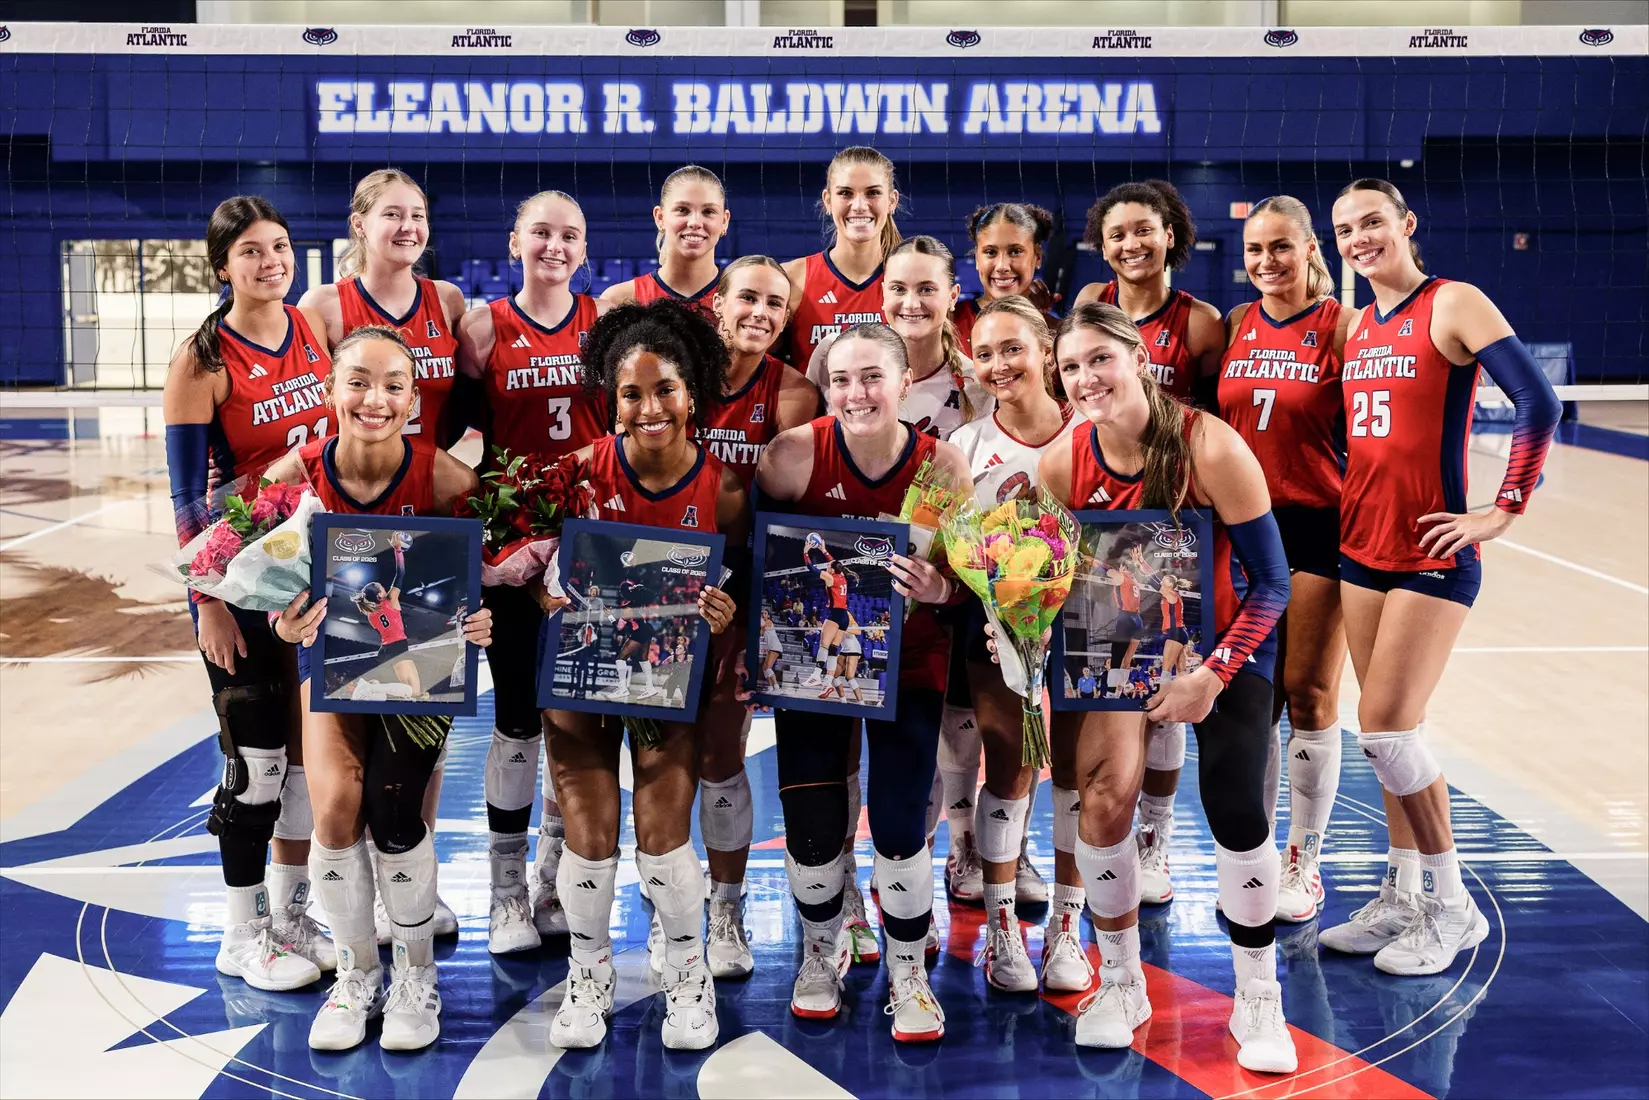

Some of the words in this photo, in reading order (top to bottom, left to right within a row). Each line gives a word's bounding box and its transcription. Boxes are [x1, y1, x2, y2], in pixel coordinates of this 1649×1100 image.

[126, 34, 188, 47] ATLANTIC
[451, 35, 512, 48] ATLANTIC
[772, 36, 833, 49] ATLANTIC
[1091, 36, 1152, 49] ATLANTIC
[1408, 35, 1468, 48] ATLANTIC
[317, 82, 588, 134] ELEANOR
[603, 83, 655, 134] R.
[672, 83, 949, 134] BALDWIN
[963, 83, 1161, 134] ARENA
[834, 312, 882, 324] FLORIDA
[1249, 349, 1296, 361] FLORIDA
[1357, 344, 1393, 359] FLORIDA
[414, 356, 455, 379] NTIC
[529, 354, 581, 367] FLORIDA
[506, 364, 585, 390] ATLAN
[1224, 360, 1320, 383] ATLANTIC
[271, 372, 319, 396] FLORIDA
[252, 381, 326, 426] ATLAN
[1253, 388, 1276, 431] 7
[548, 397, 572, 441] 3
[1351, 390, 1391, 438] 25
[379, 613, 391, 629] 8
